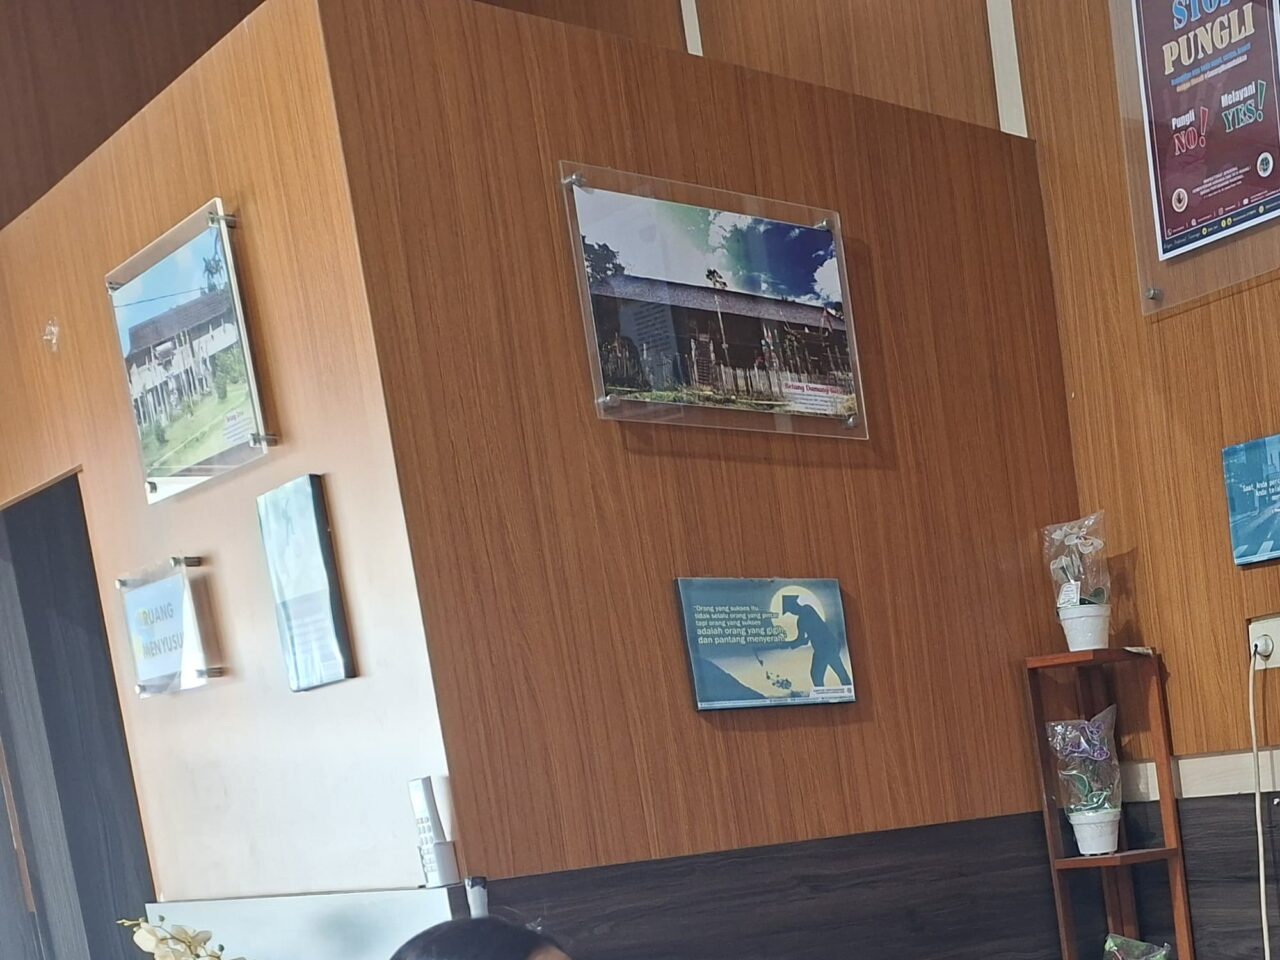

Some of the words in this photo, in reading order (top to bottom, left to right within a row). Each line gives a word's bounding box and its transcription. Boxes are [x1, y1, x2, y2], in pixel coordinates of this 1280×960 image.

[1173, 0, 1231, 30] ST
[1162, 2, 1255, 75] PUNGLI
[1221, 81, 1256, 108] Melayani
[1222, 80, 1266, 132] YES!
[1172, 109, 1195, 130] Pungli
[1173, 106, 1208, 155] NO!
[143, 602, 173, 625] RUANG
[697, 627, 723, 635] adalah
[724, 628, 747, 636] orang
[747, 628, 765, 636] yang
[698, 636, 713, 644] dan
[714, 636, 746, 645] pantang
